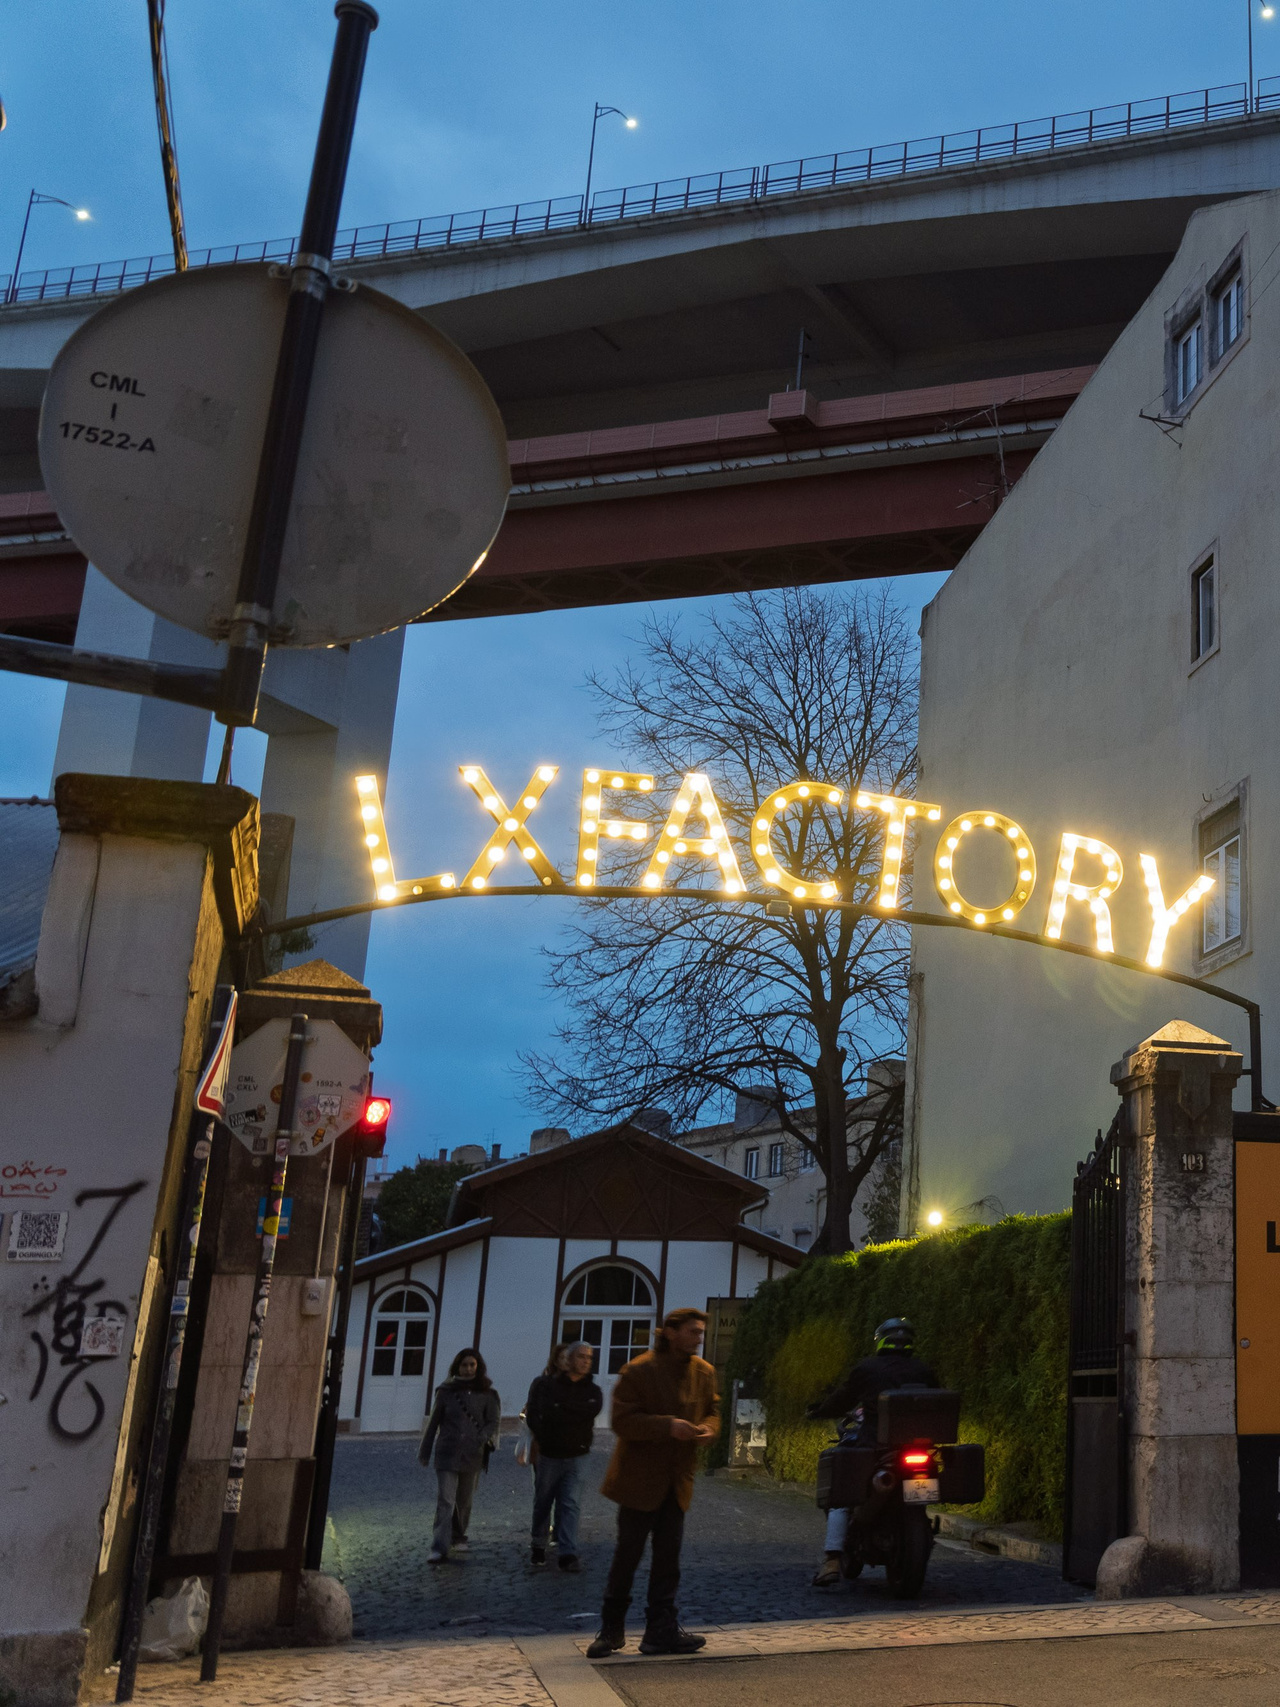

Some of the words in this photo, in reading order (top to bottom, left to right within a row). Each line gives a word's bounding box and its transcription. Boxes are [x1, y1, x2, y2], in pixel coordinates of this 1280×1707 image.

[90, 370, 146, 398] CML
[58, 420, 157, 454] 17522-A
[238, 1075, 255, 1083] CML
[1182, 1153, 1204, 1171] 103
